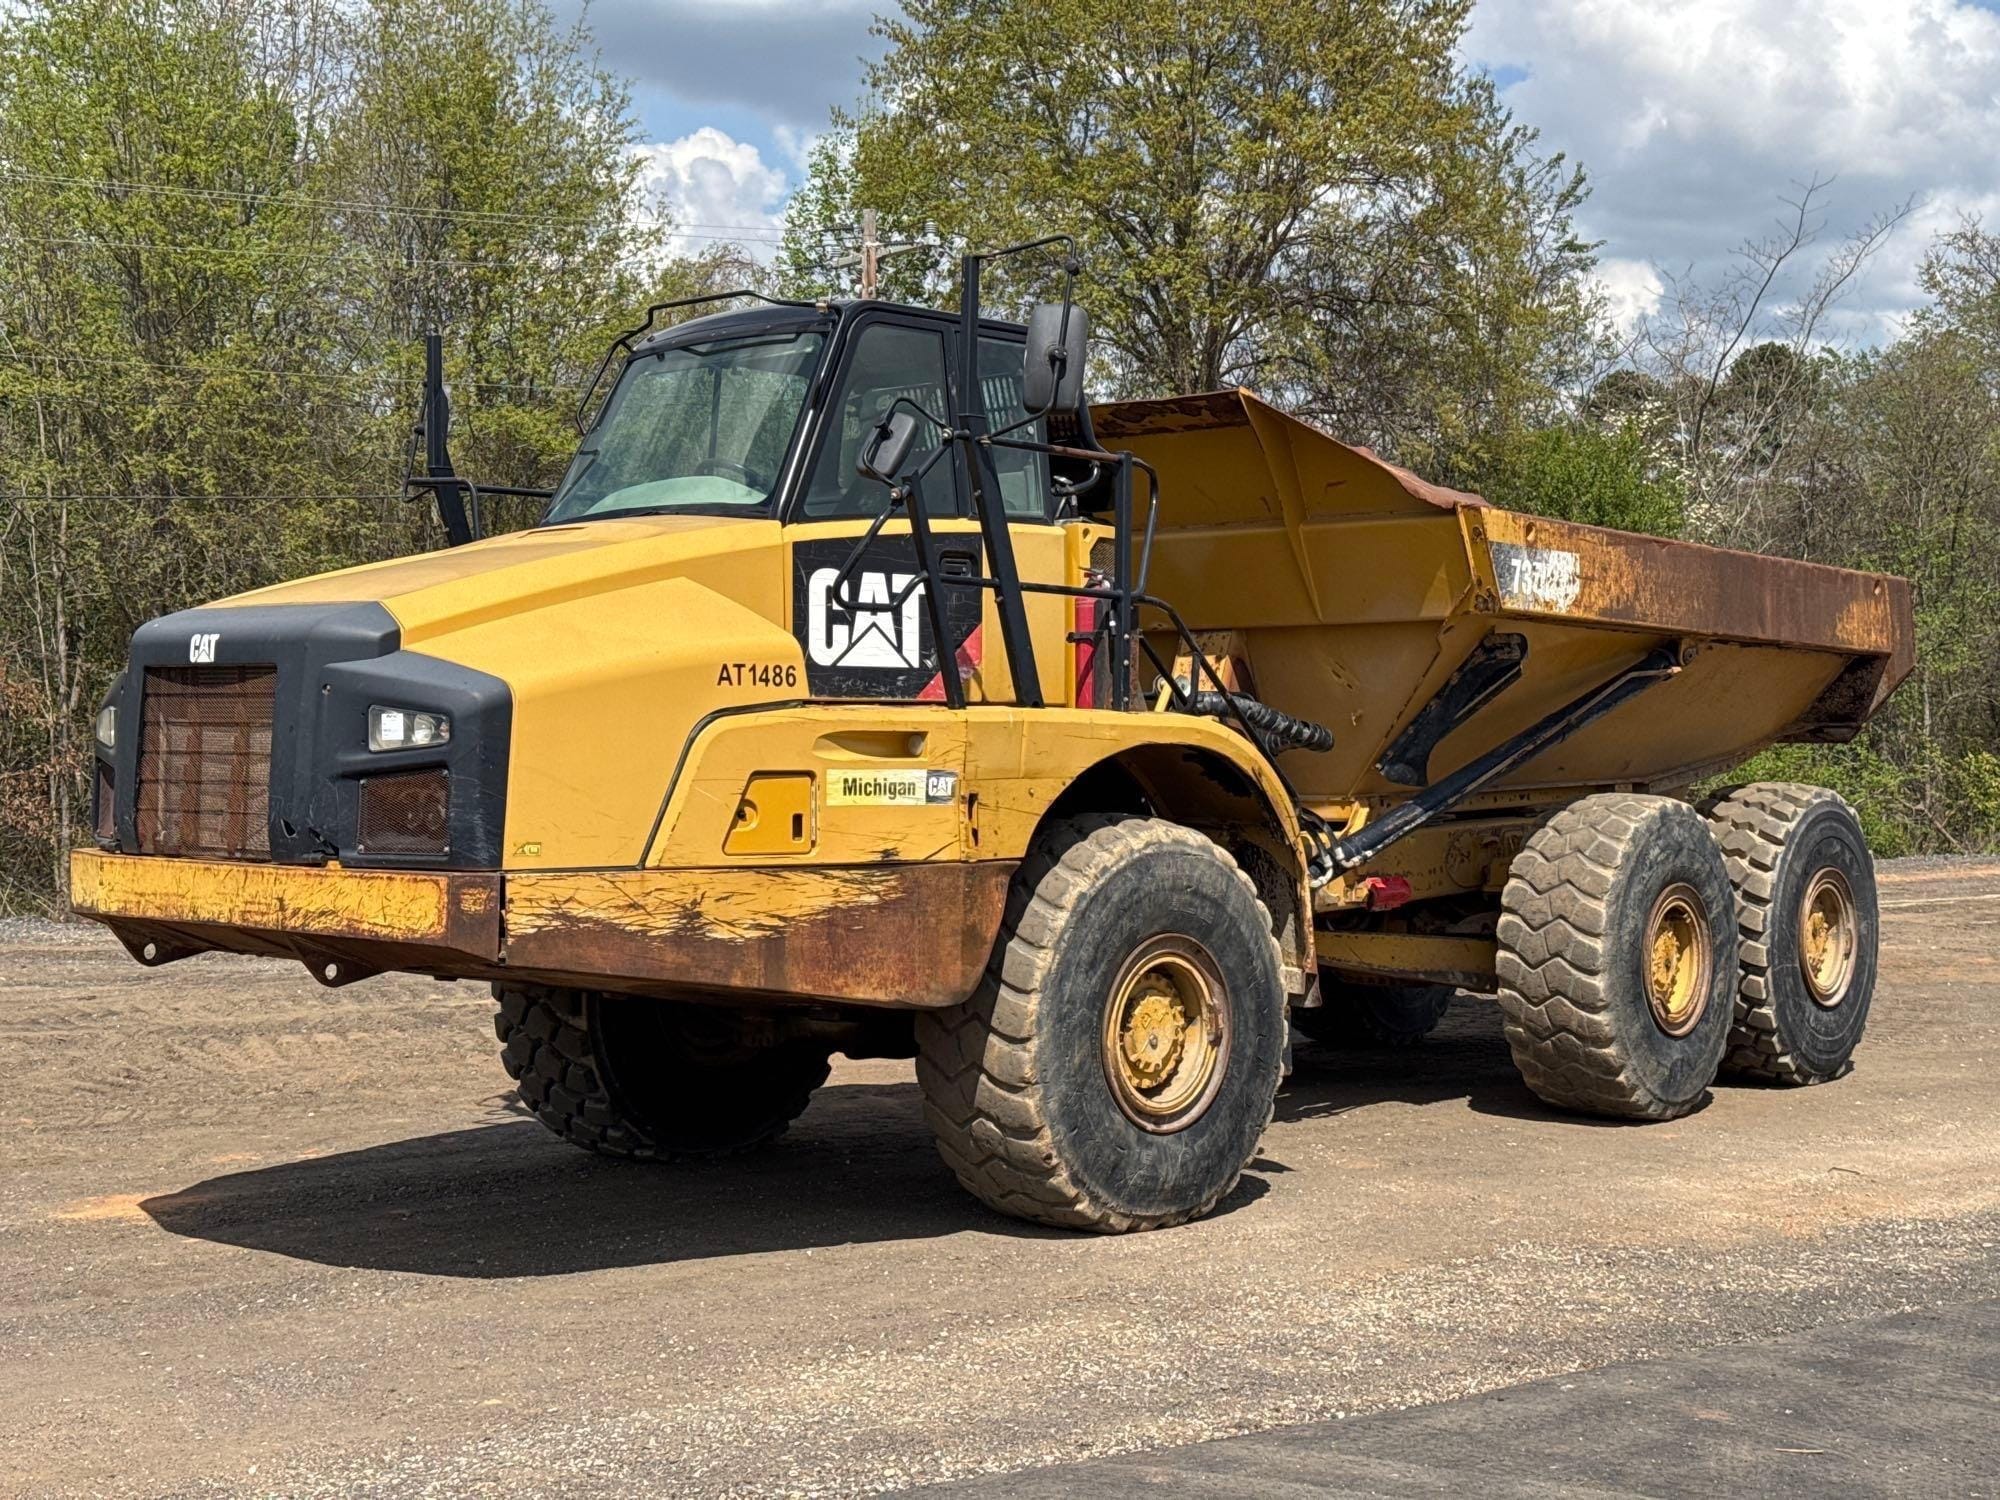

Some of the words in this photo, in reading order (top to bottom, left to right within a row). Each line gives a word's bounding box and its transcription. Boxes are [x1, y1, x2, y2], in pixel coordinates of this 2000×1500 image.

[808, 567, 925, 668] CAT
[190, 634, 220, 663] CAT
[717, 664, 797, 687] AT1486
[843, 777, 916, 800] Michigan
[928, 777, 957, 796] CAT
